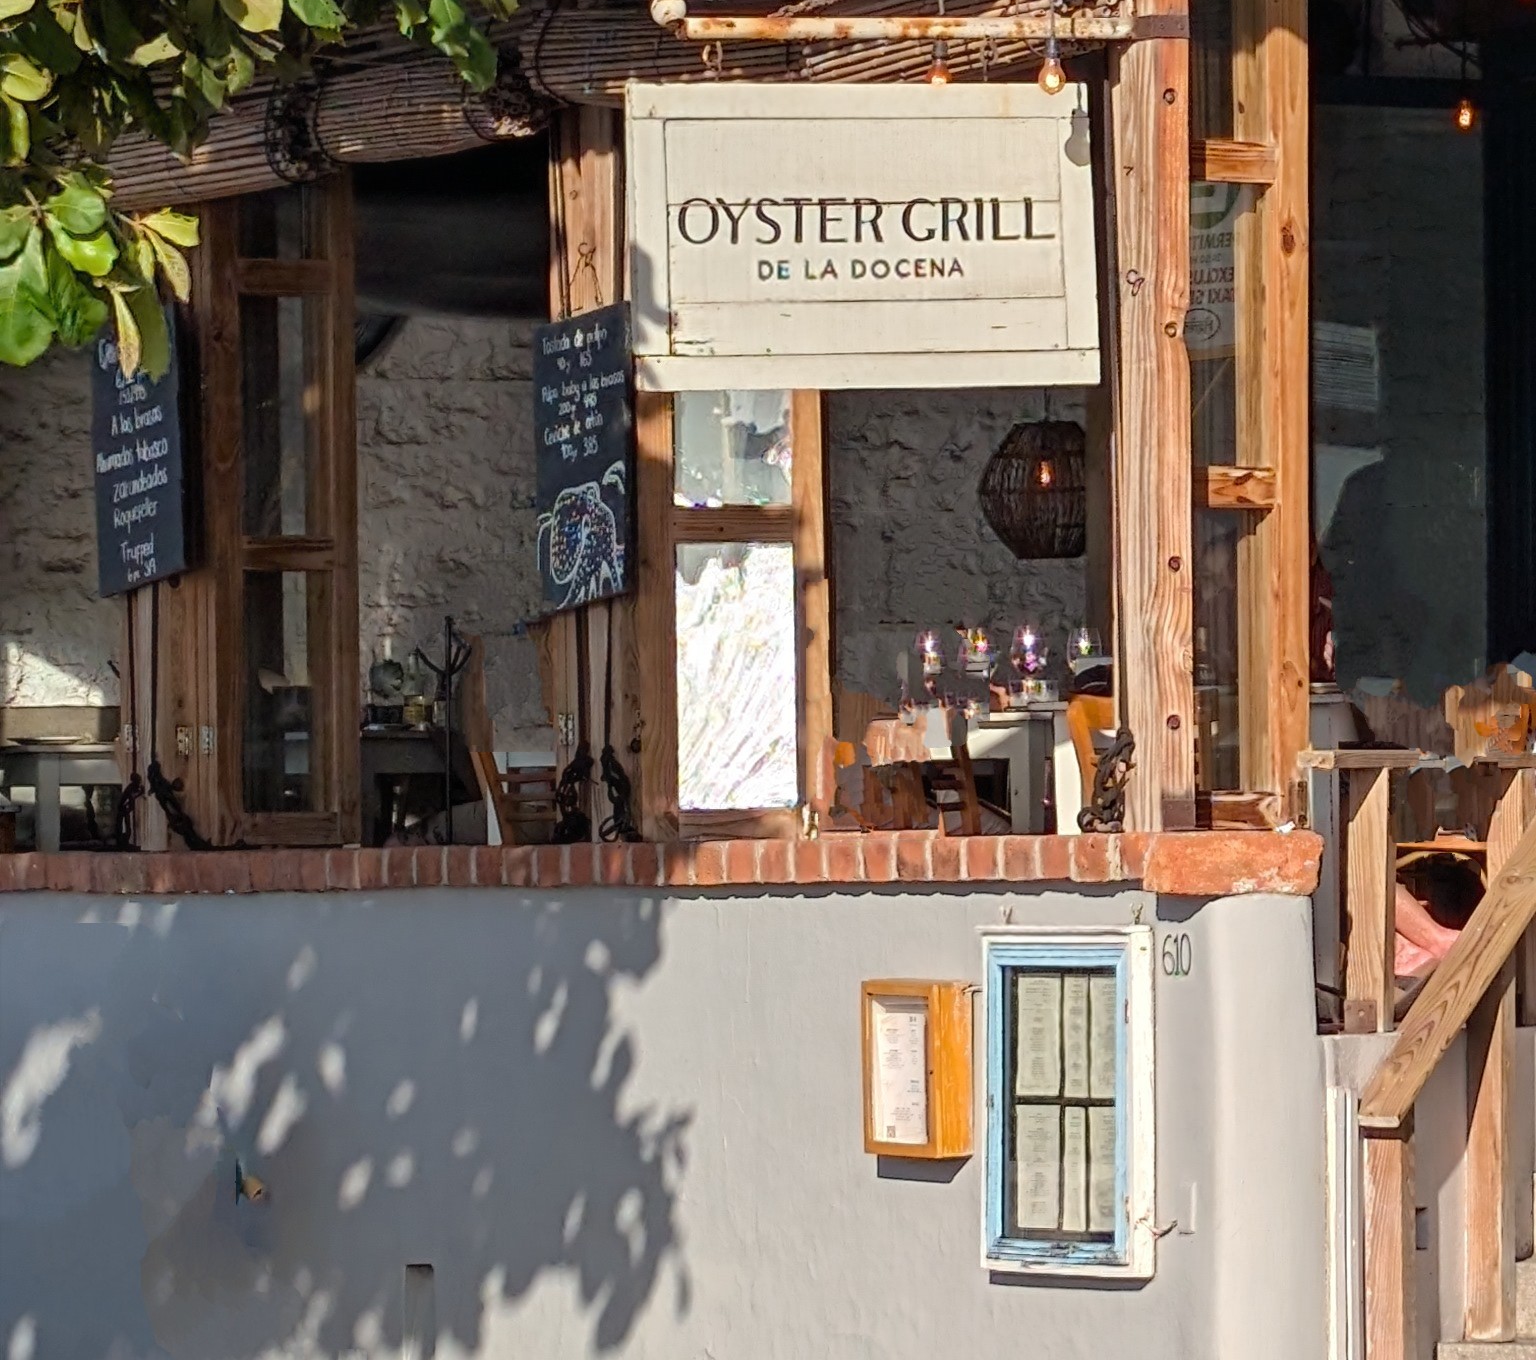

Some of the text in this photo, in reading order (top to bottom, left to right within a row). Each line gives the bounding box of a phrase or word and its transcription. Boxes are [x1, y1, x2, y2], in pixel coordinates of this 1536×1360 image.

[677, 197, 1056, 245] OYSTER GRILL
[757, 257, 965, 280] DE LA DOCENA
[1162, 933, 1192, 976] 610
